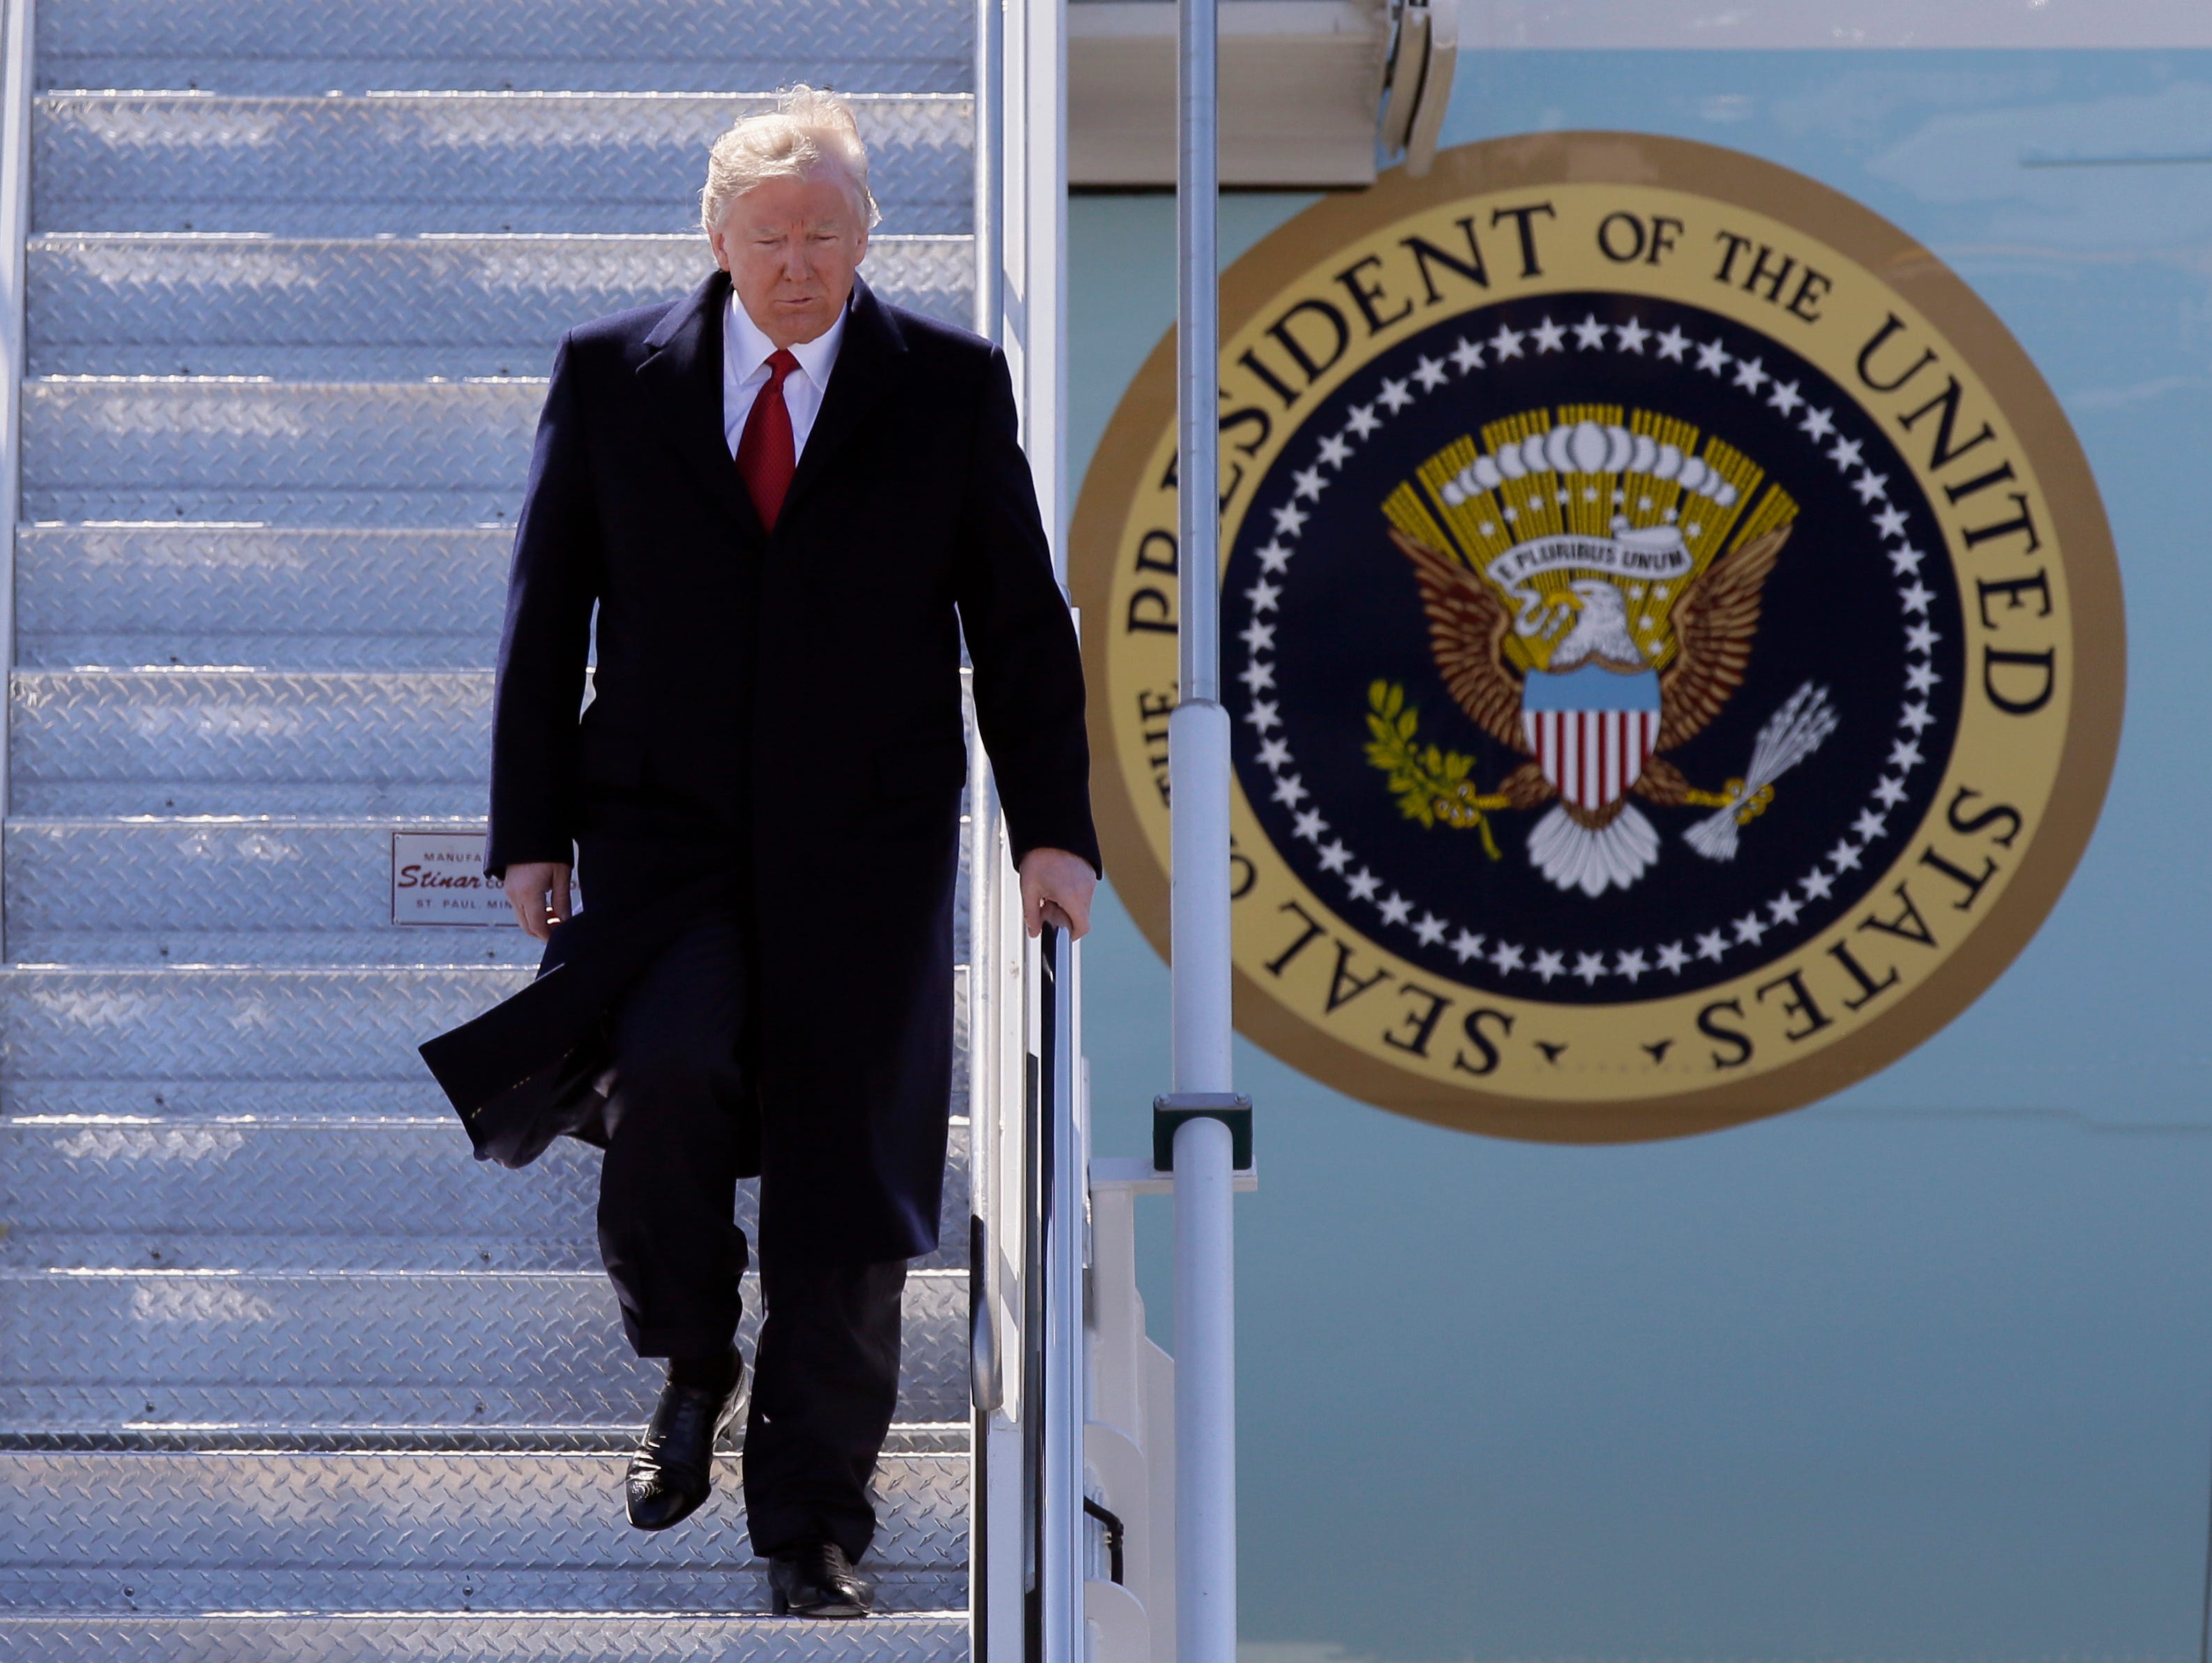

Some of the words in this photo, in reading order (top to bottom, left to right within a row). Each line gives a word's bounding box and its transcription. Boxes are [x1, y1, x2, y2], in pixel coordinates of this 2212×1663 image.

[1597, 211, 1684, 266] OF
[1714, 229, 1833, 323] THE
[1856, 313, 2056, 716] UNITED
[398, 865, 481, 888] Stinar
[424, 853, 481, 862] MANUFA
[1696, 786, 2022, 1070] STATES
[1264, 899, 1517, 1076] SEAL
